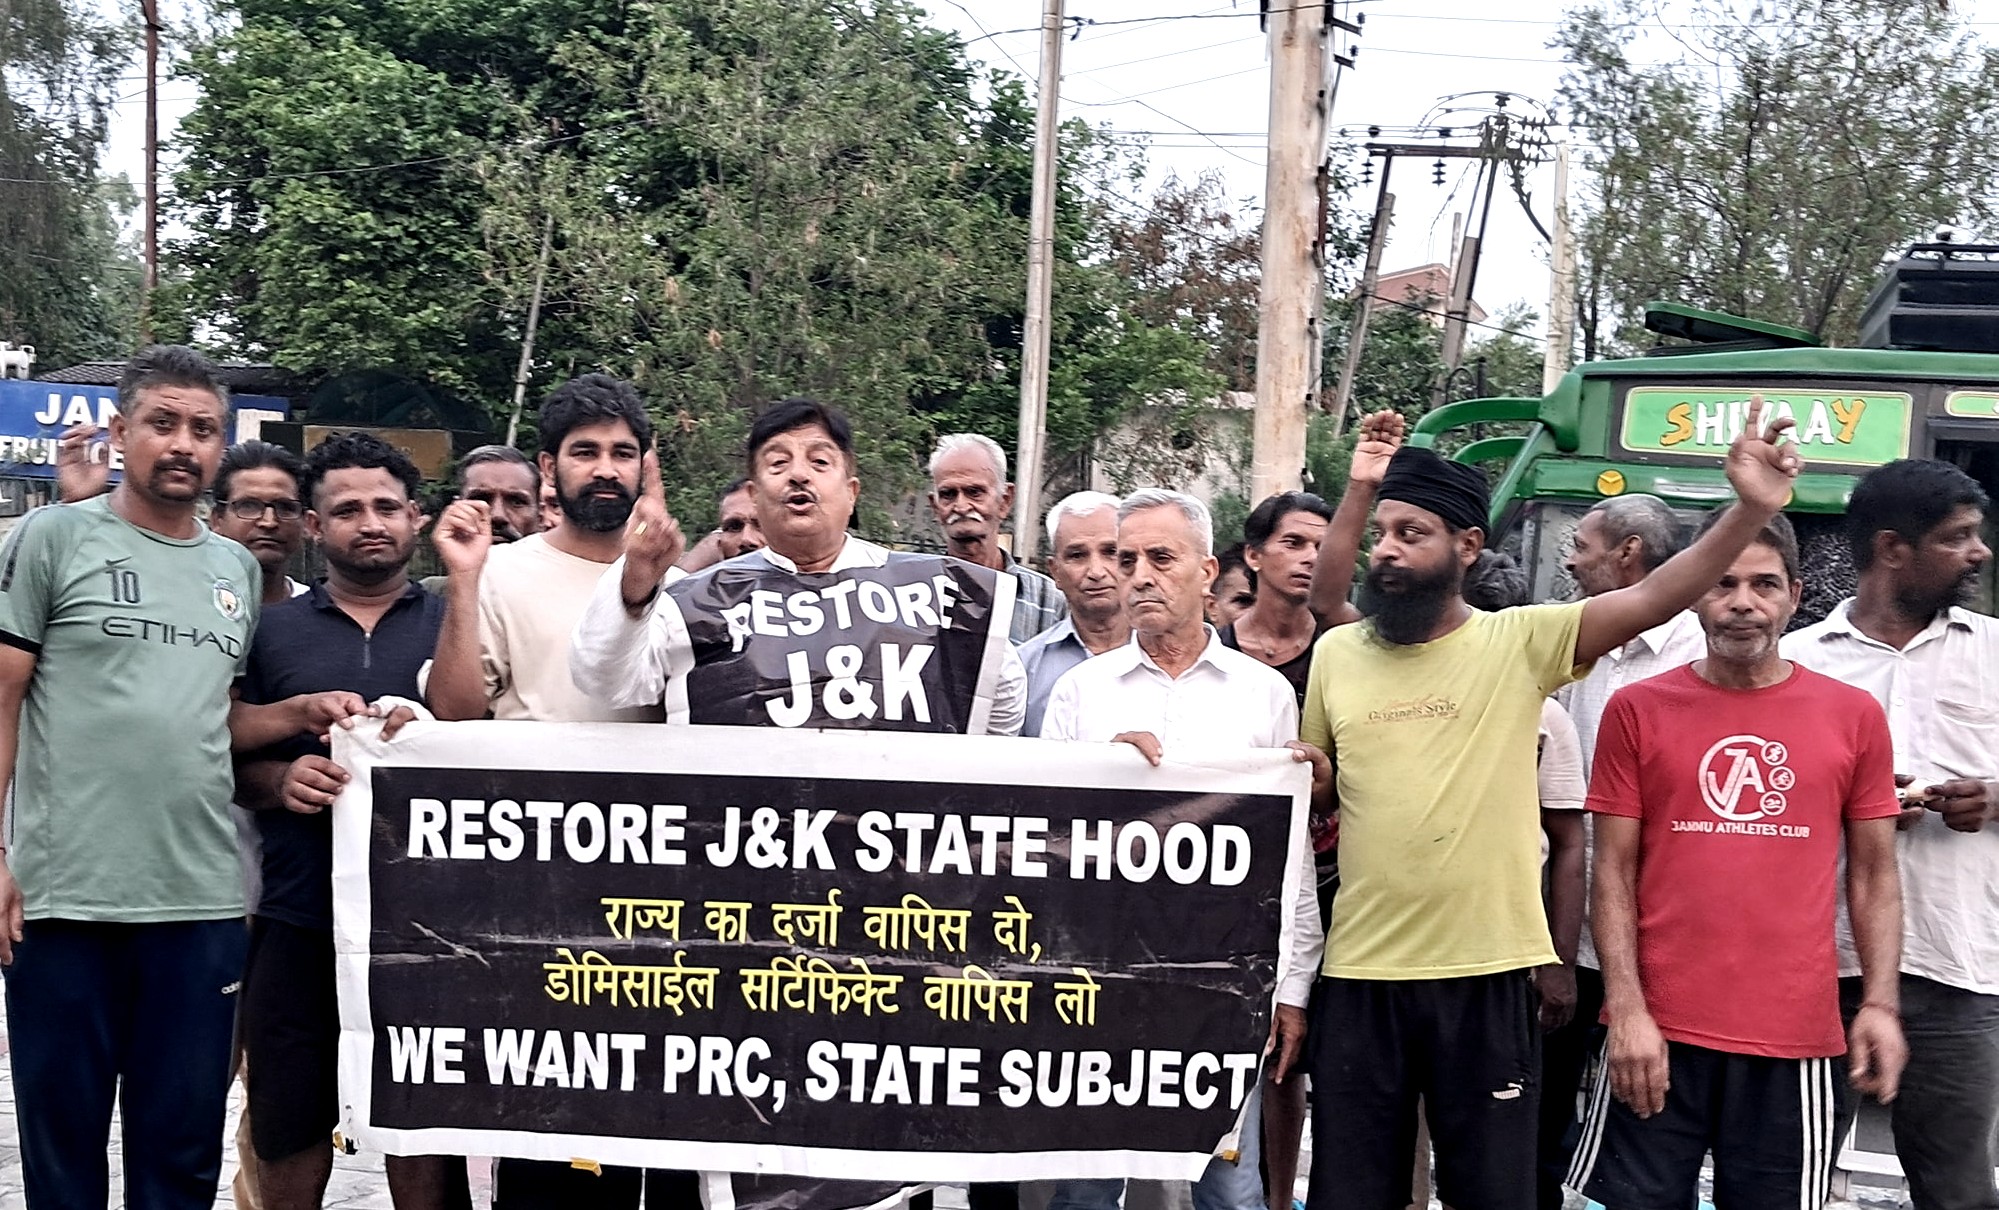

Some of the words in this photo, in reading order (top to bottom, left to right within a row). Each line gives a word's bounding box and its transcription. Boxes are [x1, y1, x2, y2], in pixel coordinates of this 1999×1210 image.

[105, 569, 142, 603] 10
[720, 575, 960, 652] RESTORE
[102, 616, 243, 660] ETIHAD
[765, 643, 936, 728] J&K
[407, 798, 687, 865] RESTORE
[705, 806, 837, 870] J&K
[854, 810, 1049, 878] STATE
[1069, 818, 1251, 887] HOOD
[1716, 821, 1777, 836] ATHLETES
[1779, 824, 1810, 838] CLUB
[601, 897, 684, 942] राज्य
[704, 900, 752, 943] का
[771, 889, 843, 947] दर्जा
[863, 893, 972, 953] वापिस
[992, 896, 1042, 964] दो,
[543, 948, 720, 1017] डोमिसाईल
[923, 965, 1032, 1023] वापिस
[1054, 968, 1101, 1027] लो
[387, 1026, 466, 1085] WE
[483, 1028, 646, 1092] WANT
[663, 1034, 787, 1114] PRC,
[806, 1040, 981, 1107] STATE
[998, 1049, 1257, 1110] SUBJECT
